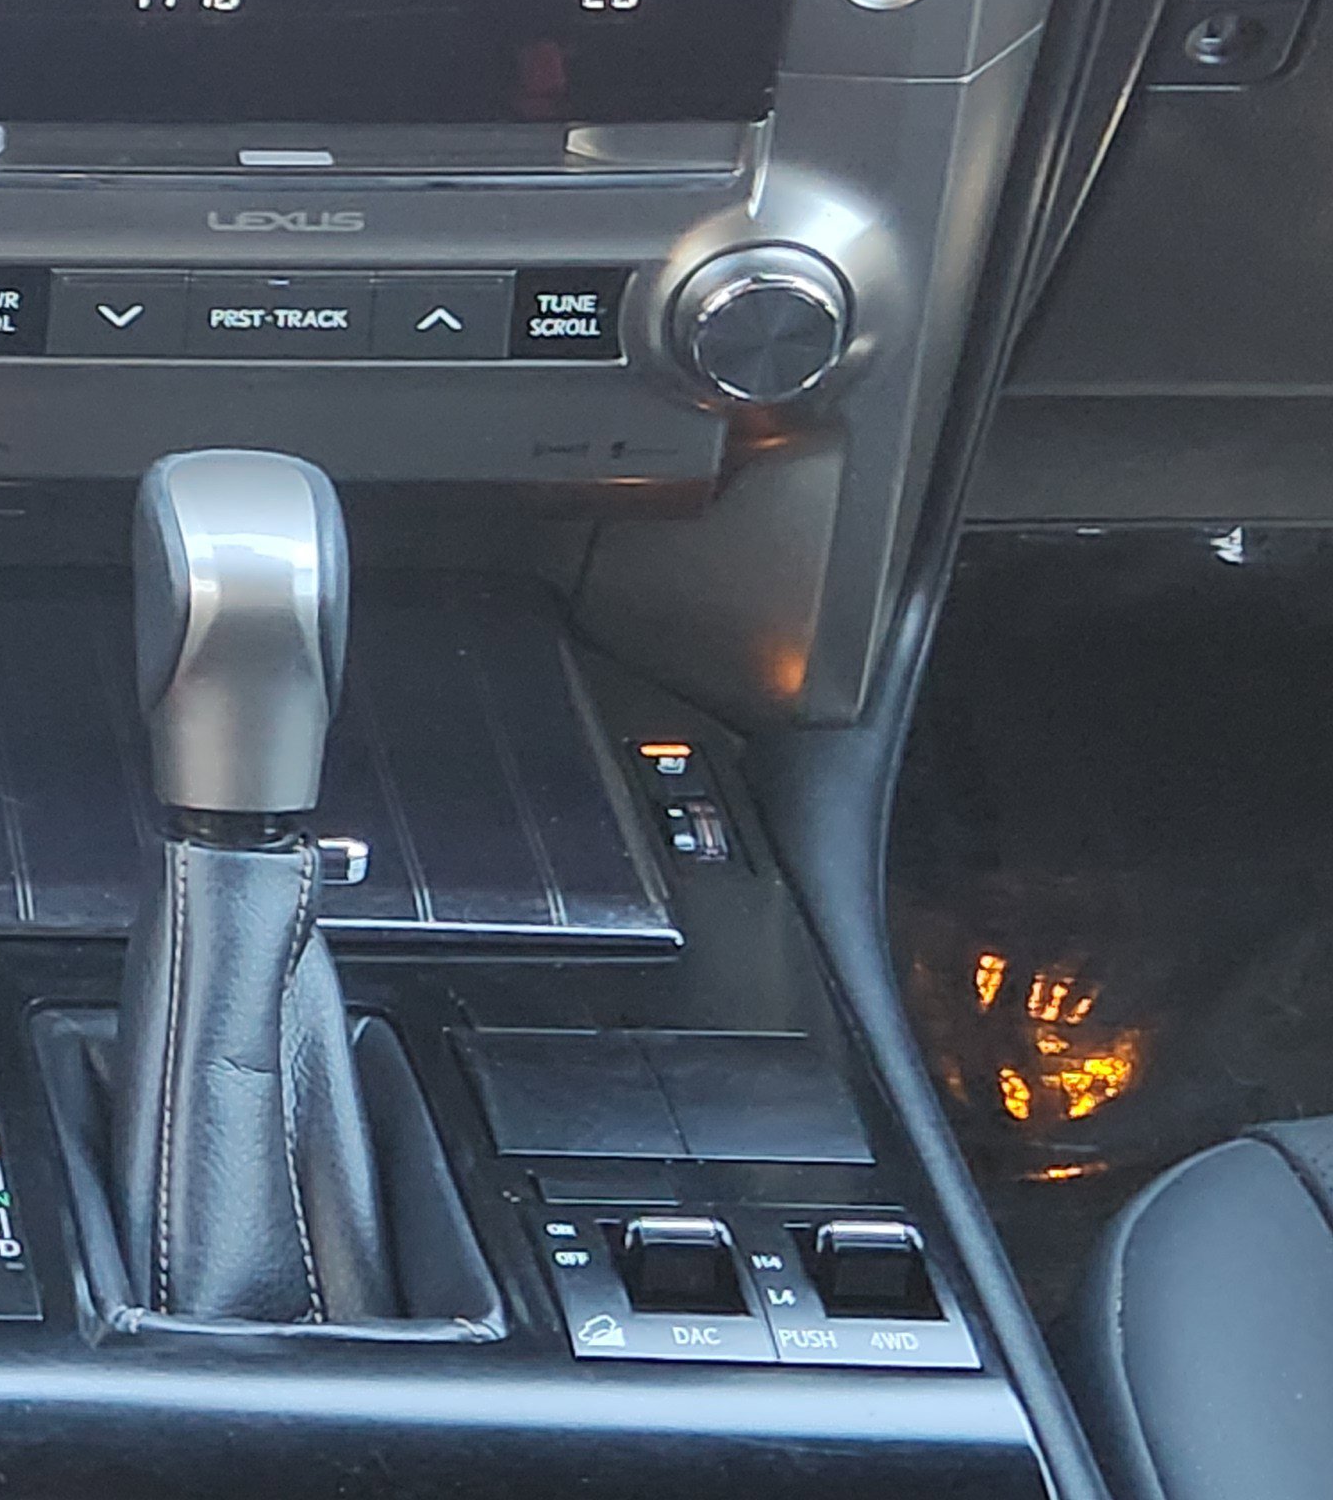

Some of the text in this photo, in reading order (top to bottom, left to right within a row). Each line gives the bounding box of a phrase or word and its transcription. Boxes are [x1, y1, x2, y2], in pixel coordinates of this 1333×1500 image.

[206, 210, 367, 233] LEXUS
[536, 294, 597, 314] TUNE
[529, 317, 601, 338] SCROLL
[554, 1250, 591, 1267] OFF
[673, 1326, 722, 1346] DAC
[779, 1329, 920, 1351] PUSH 4WD
